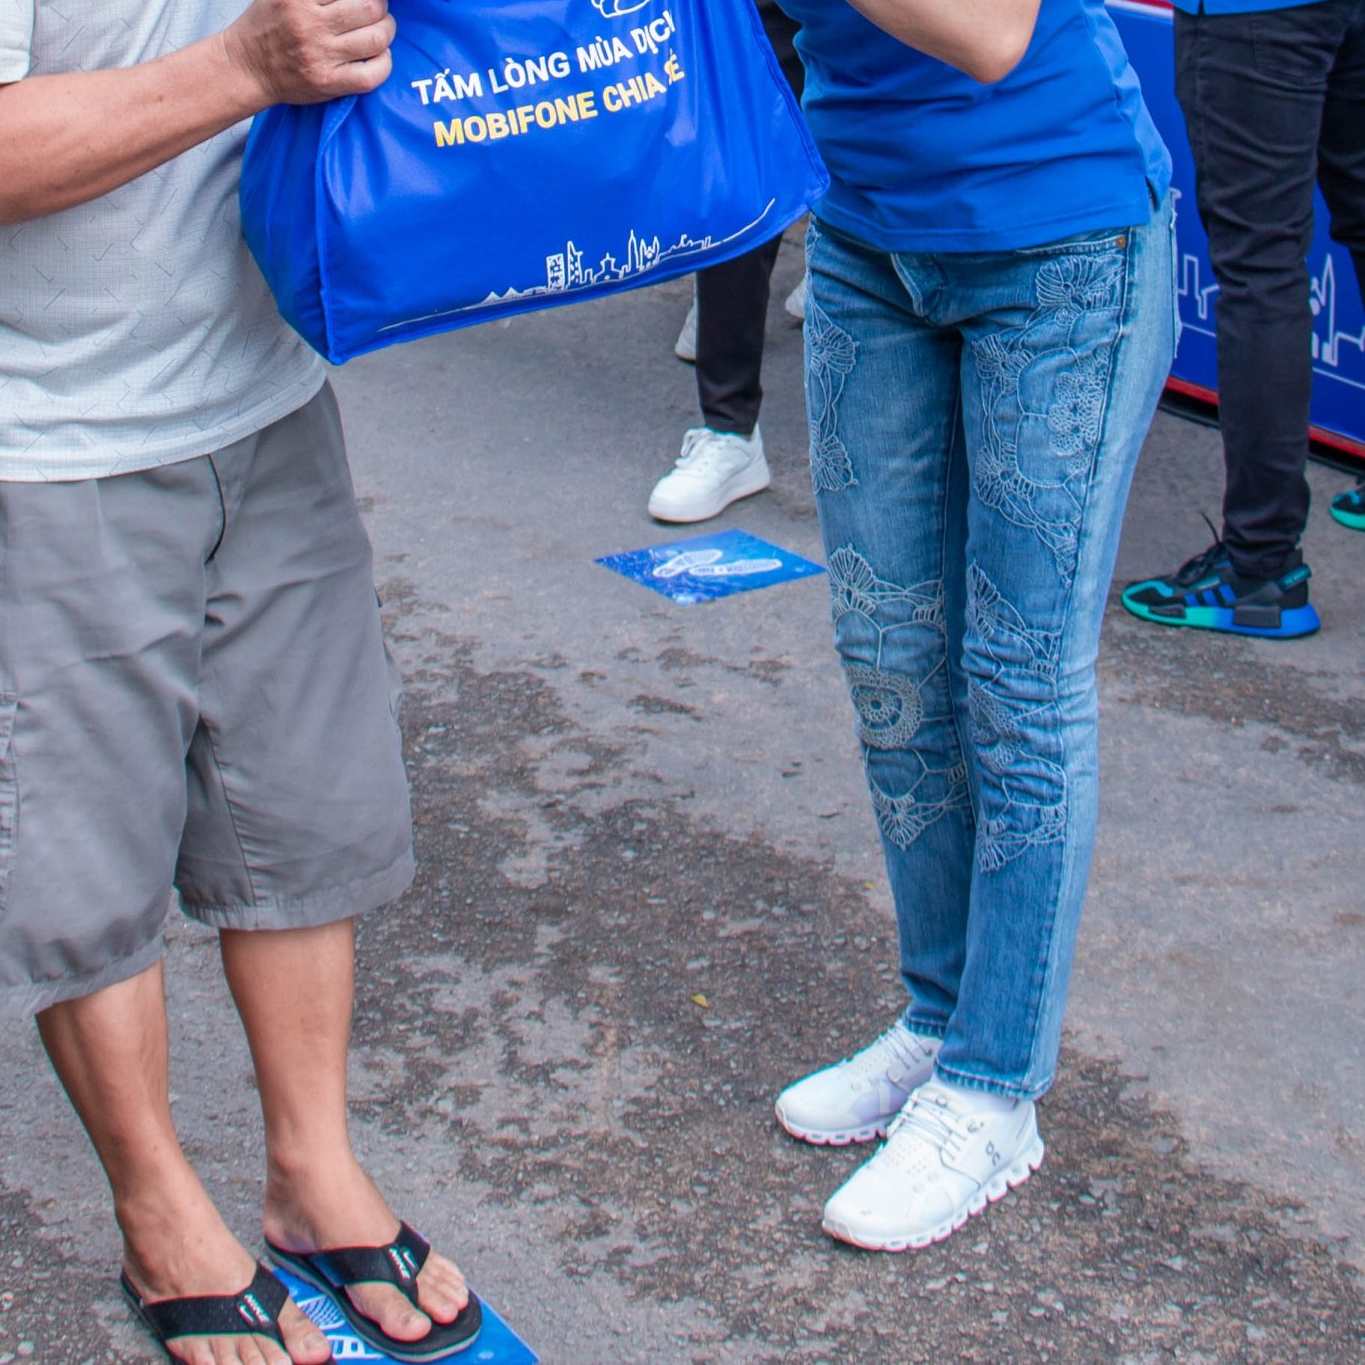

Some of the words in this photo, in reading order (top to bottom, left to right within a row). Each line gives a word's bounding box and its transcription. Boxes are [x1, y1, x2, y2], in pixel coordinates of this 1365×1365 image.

[411, 68, 484, 105] TẤM
[487, 52, 571, 95] LÒNG
[576, 35, 633, 73] MÙA
[433, 91, 598, 148] MOBIFONE
[602, 71, 667, 113] CHIA
